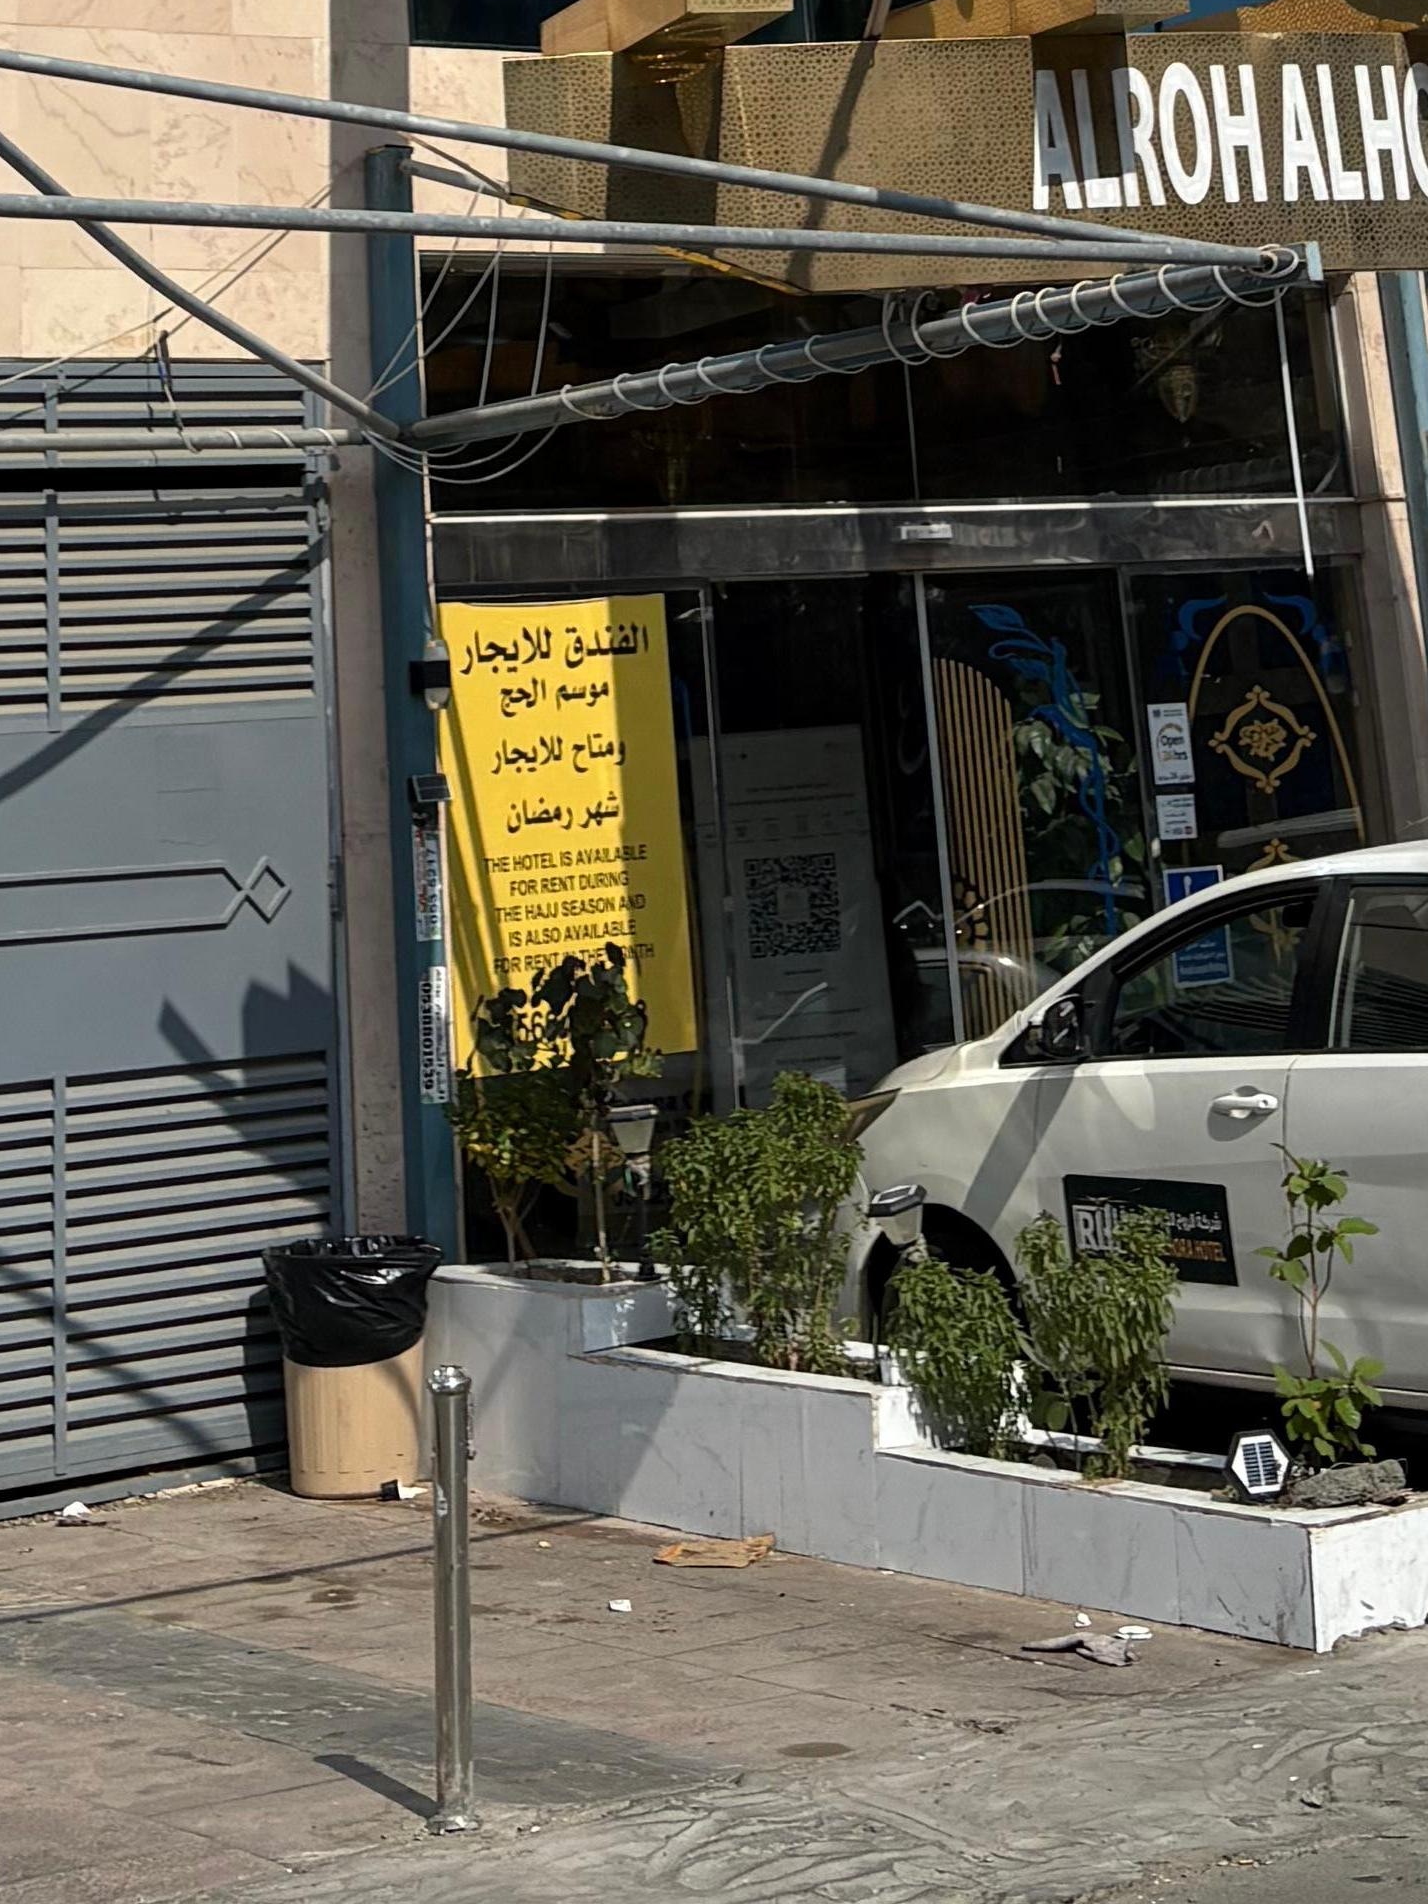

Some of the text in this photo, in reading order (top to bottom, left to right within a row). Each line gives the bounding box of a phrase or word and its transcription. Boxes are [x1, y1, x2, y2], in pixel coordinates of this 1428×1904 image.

[1032, 61, 1268, 210] ALROH
[460, 623, 649, 675] الفندق للايجار
[500, 677, 609, 717] موسم الحج
[491, 733, 626, 775] ومتاح للايجار
[507, 791, 619, 833] شهر رمضان
[484, 844, 647, 874] THE HOTEL IS AVAILABLE
[510, 871, 630, 896] FOR RENT DURING
[495, 906, 522, 924] THE
[561, 897, 615, 917] SEASON
[619, 893, 646, 910] AND
[509, 919, 636, 947] IS ALSO AVAILABLE
[494, 957, 521, 974] FOR
